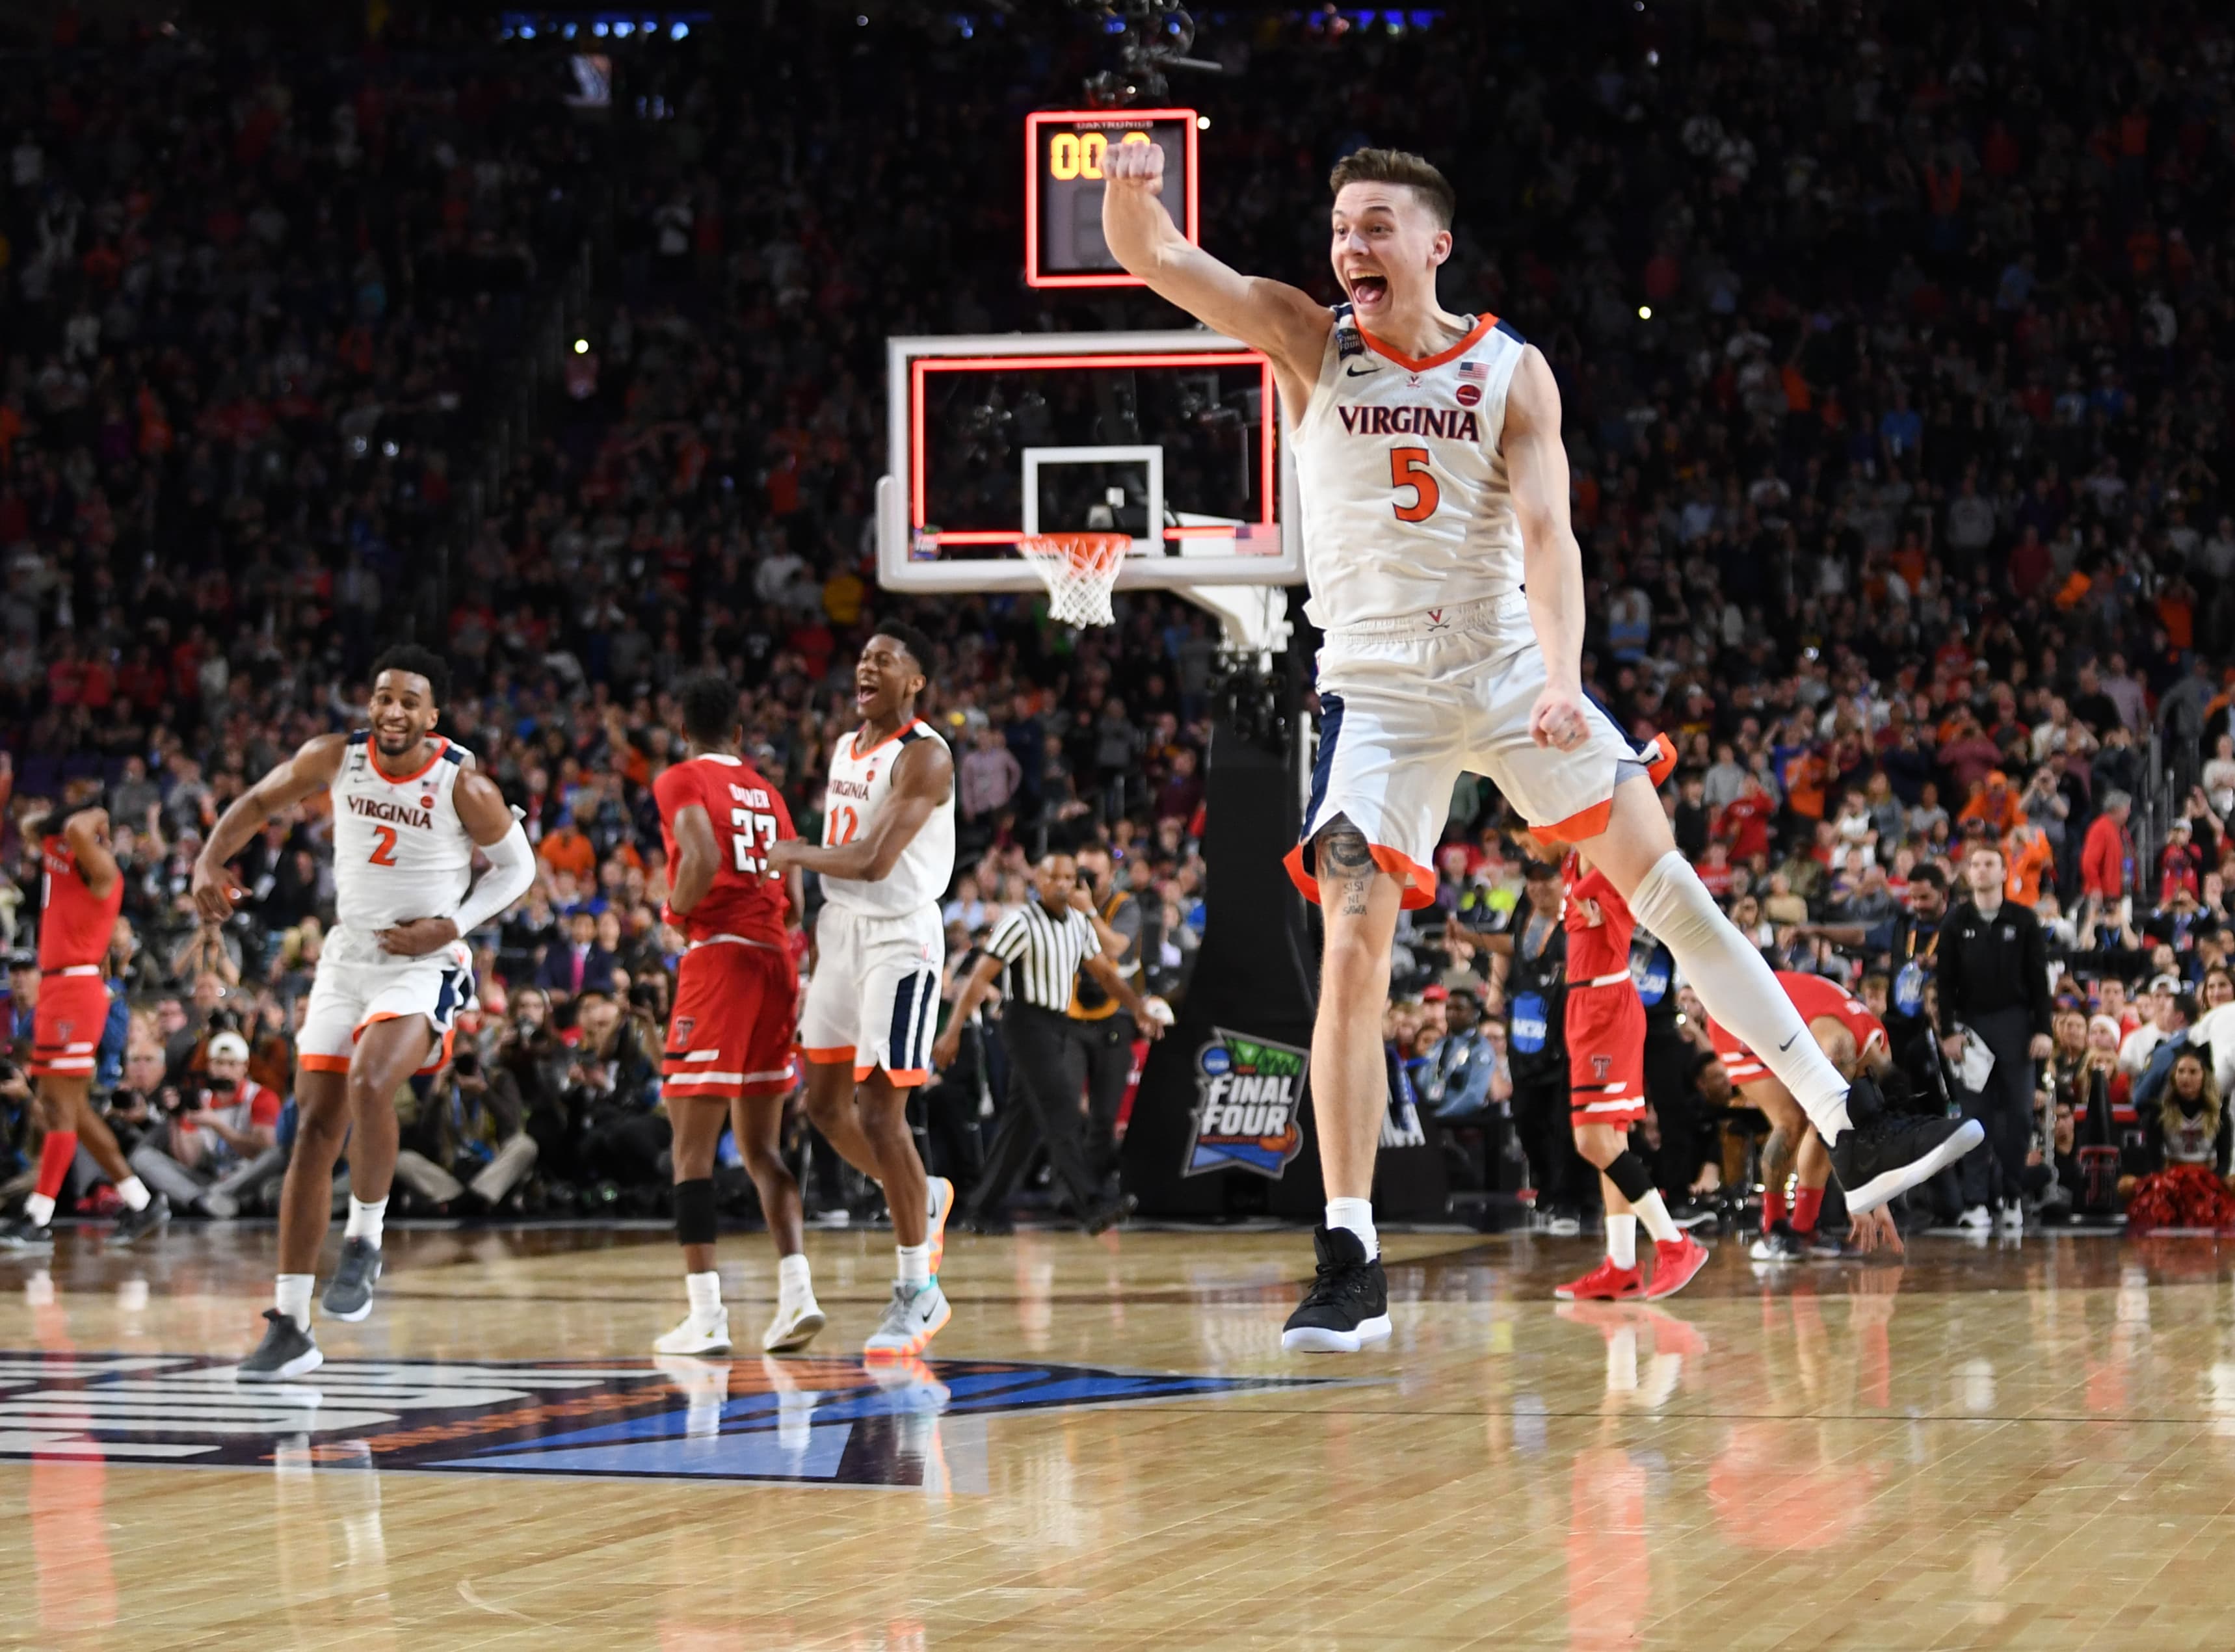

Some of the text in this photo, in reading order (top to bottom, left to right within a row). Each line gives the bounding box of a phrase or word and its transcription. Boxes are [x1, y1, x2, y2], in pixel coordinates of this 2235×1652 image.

[1338, 406, 1479, 443] VIRGINIA
[1390, 447, 1440, 523] 5
[347, 795, 432, 830] VIRGINIA
[827, 804, 862, 845] 12
[369, 825, 397, 867] 2
[1209, 1072, 1293, 1104] FINAL
[1201, 1105, 1289, 1136] FOUR
